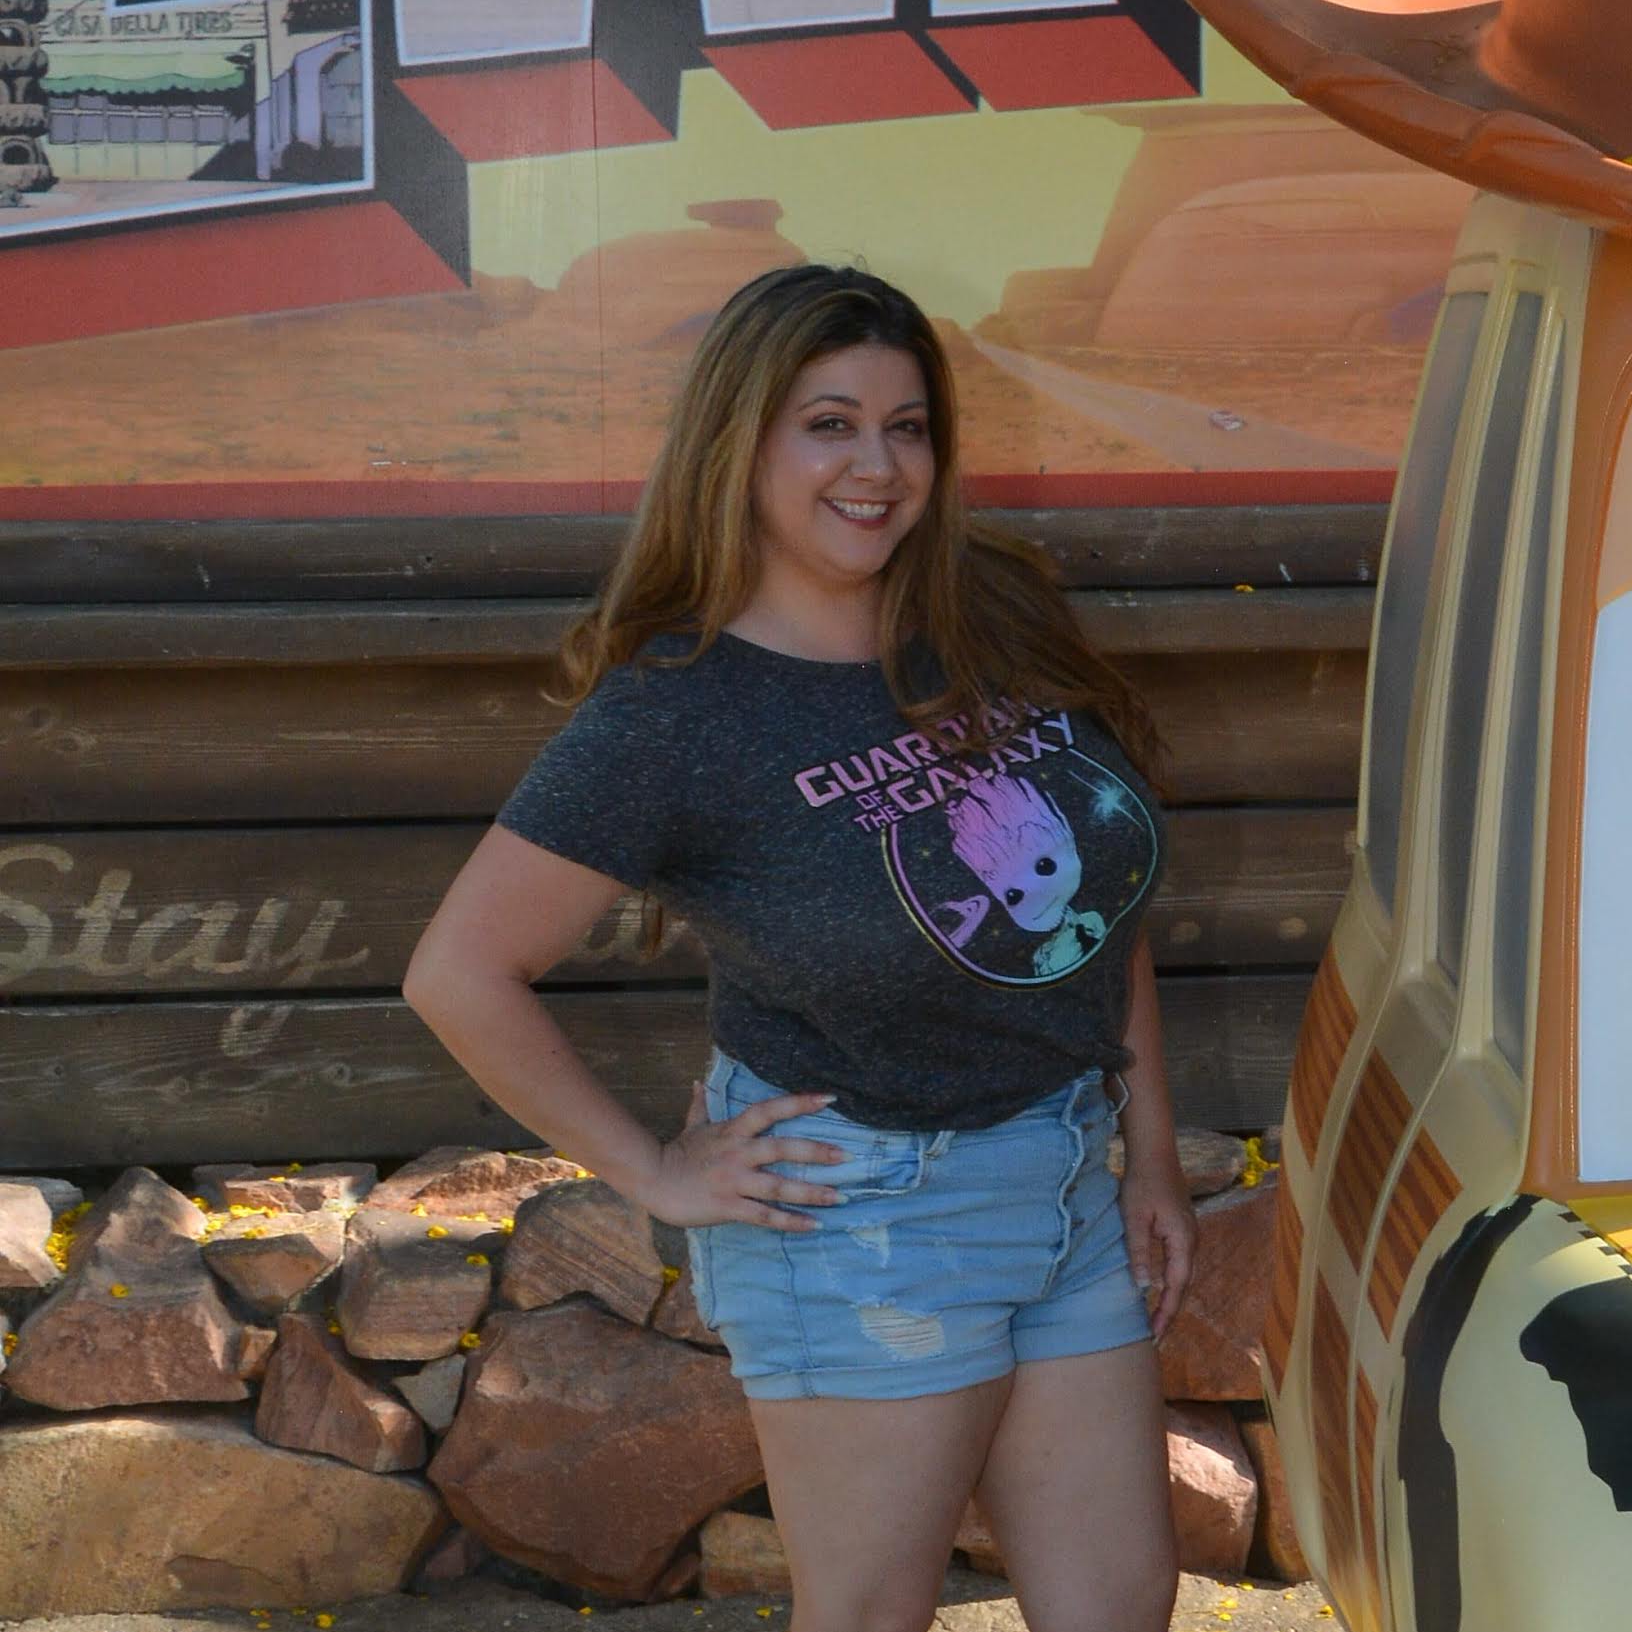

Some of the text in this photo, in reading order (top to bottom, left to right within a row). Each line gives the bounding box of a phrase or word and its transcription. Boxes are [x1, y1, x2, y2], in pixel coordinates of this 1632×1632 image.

[54, 12, 101, 37] CASA
[110, 12, 169, 35] DELLA
[886, 711, 1075, 814] GALAXY
[855, 788, 887, 811] OF
[853, 803, 904, 834] THE
[0, 843, 371, 1057] Stay
